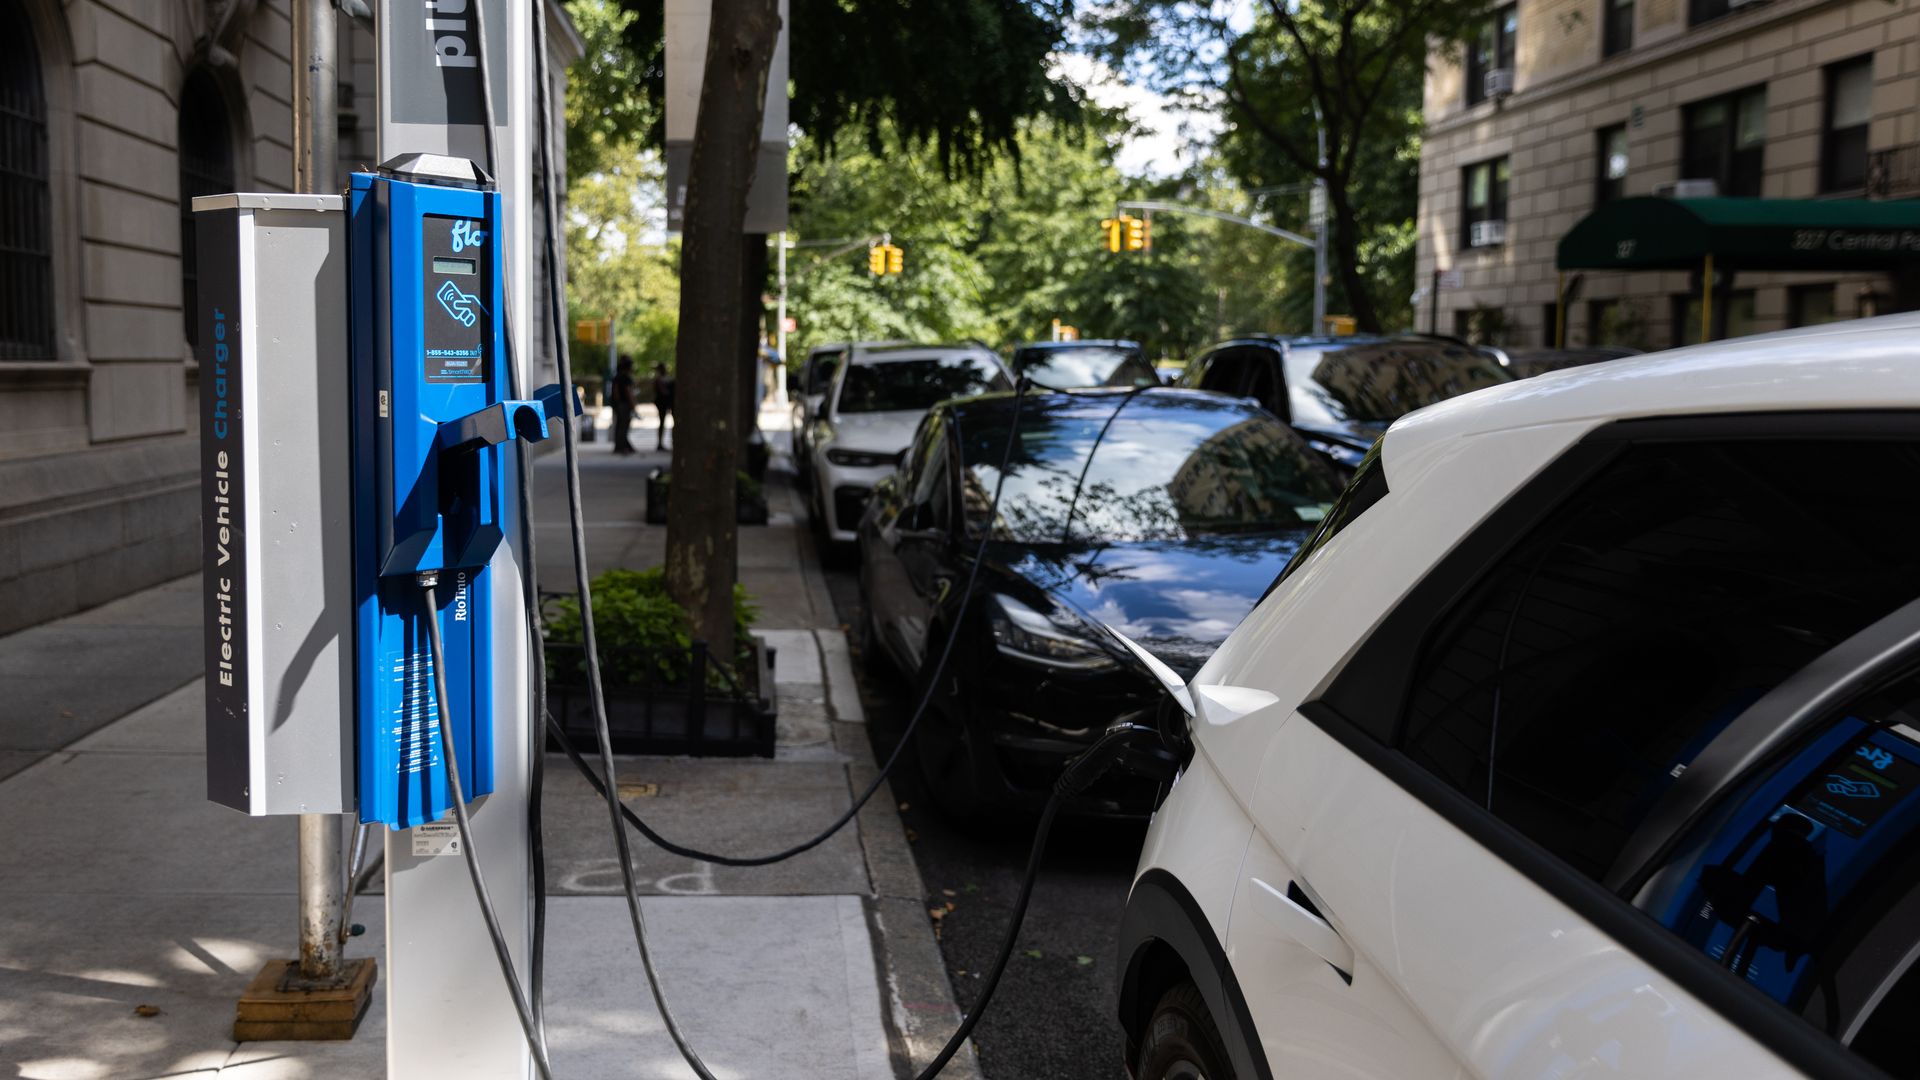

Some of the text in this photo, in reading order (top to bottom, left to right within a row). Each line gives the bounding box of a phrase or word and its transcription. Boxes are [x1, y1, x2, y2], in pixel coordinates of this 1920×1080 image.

[1828, 229, 1896, 251] Central
[214, 307, 233, 687] Electric Vehicle Charger
